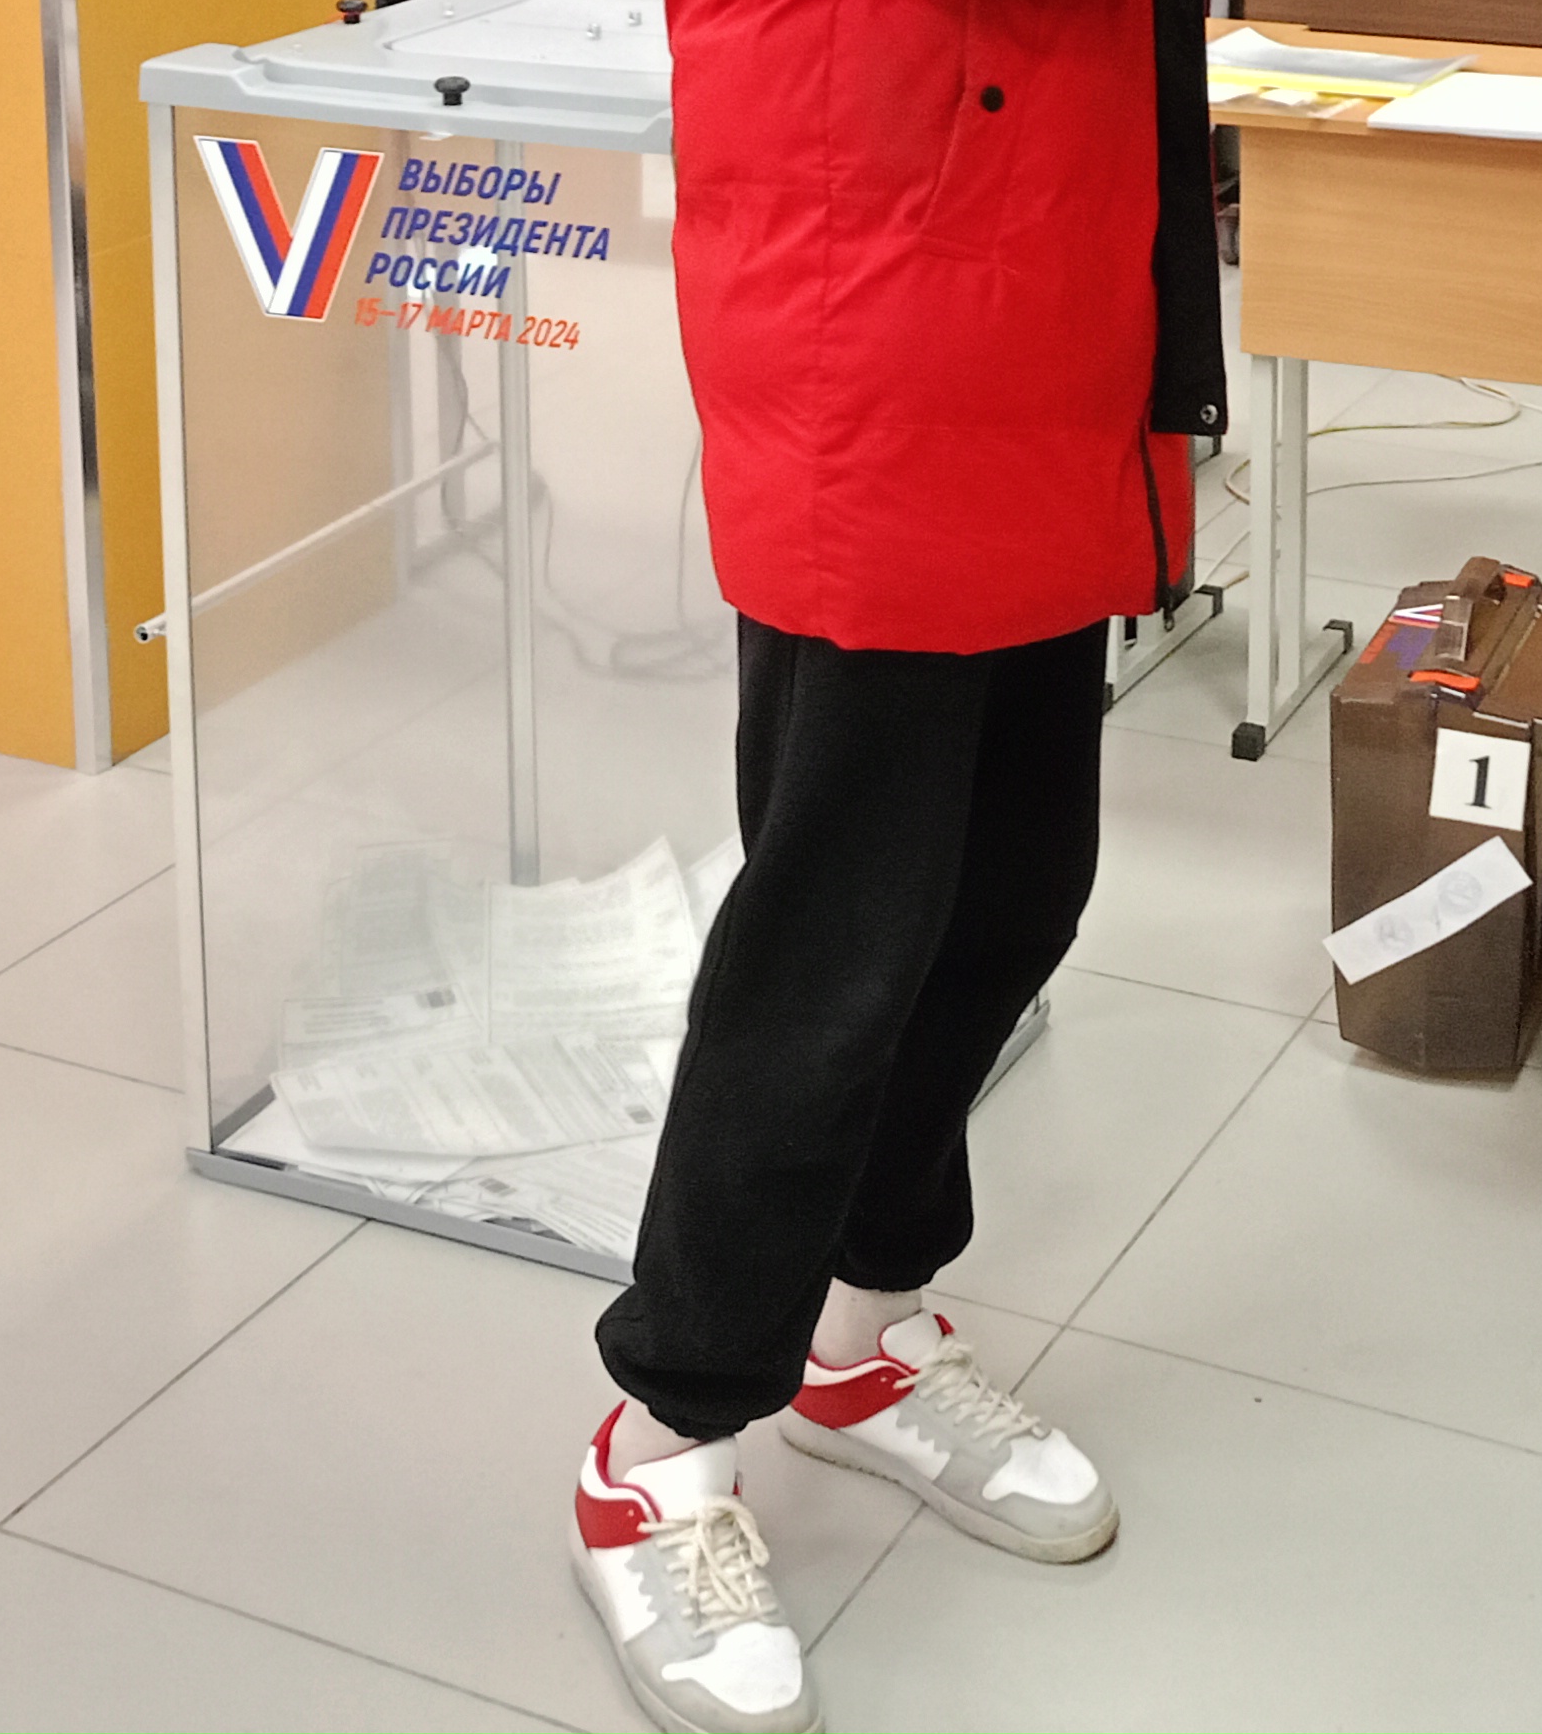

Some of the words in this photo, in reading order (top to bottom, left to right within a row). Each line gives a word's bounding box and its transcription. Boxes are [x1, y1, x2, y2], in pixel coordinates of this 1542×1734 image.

[398, 158, 561, 205] ВЫБОРЫ
[380, 206, 611, 261] ПРЕЗИДЕНТА
[365, 252, 511, 299] РОССИИ
[425, 303, 512, 342] МАРТА
[516, 315, 581, 350] 2024
[1463, 754, 1493, 811] 1
